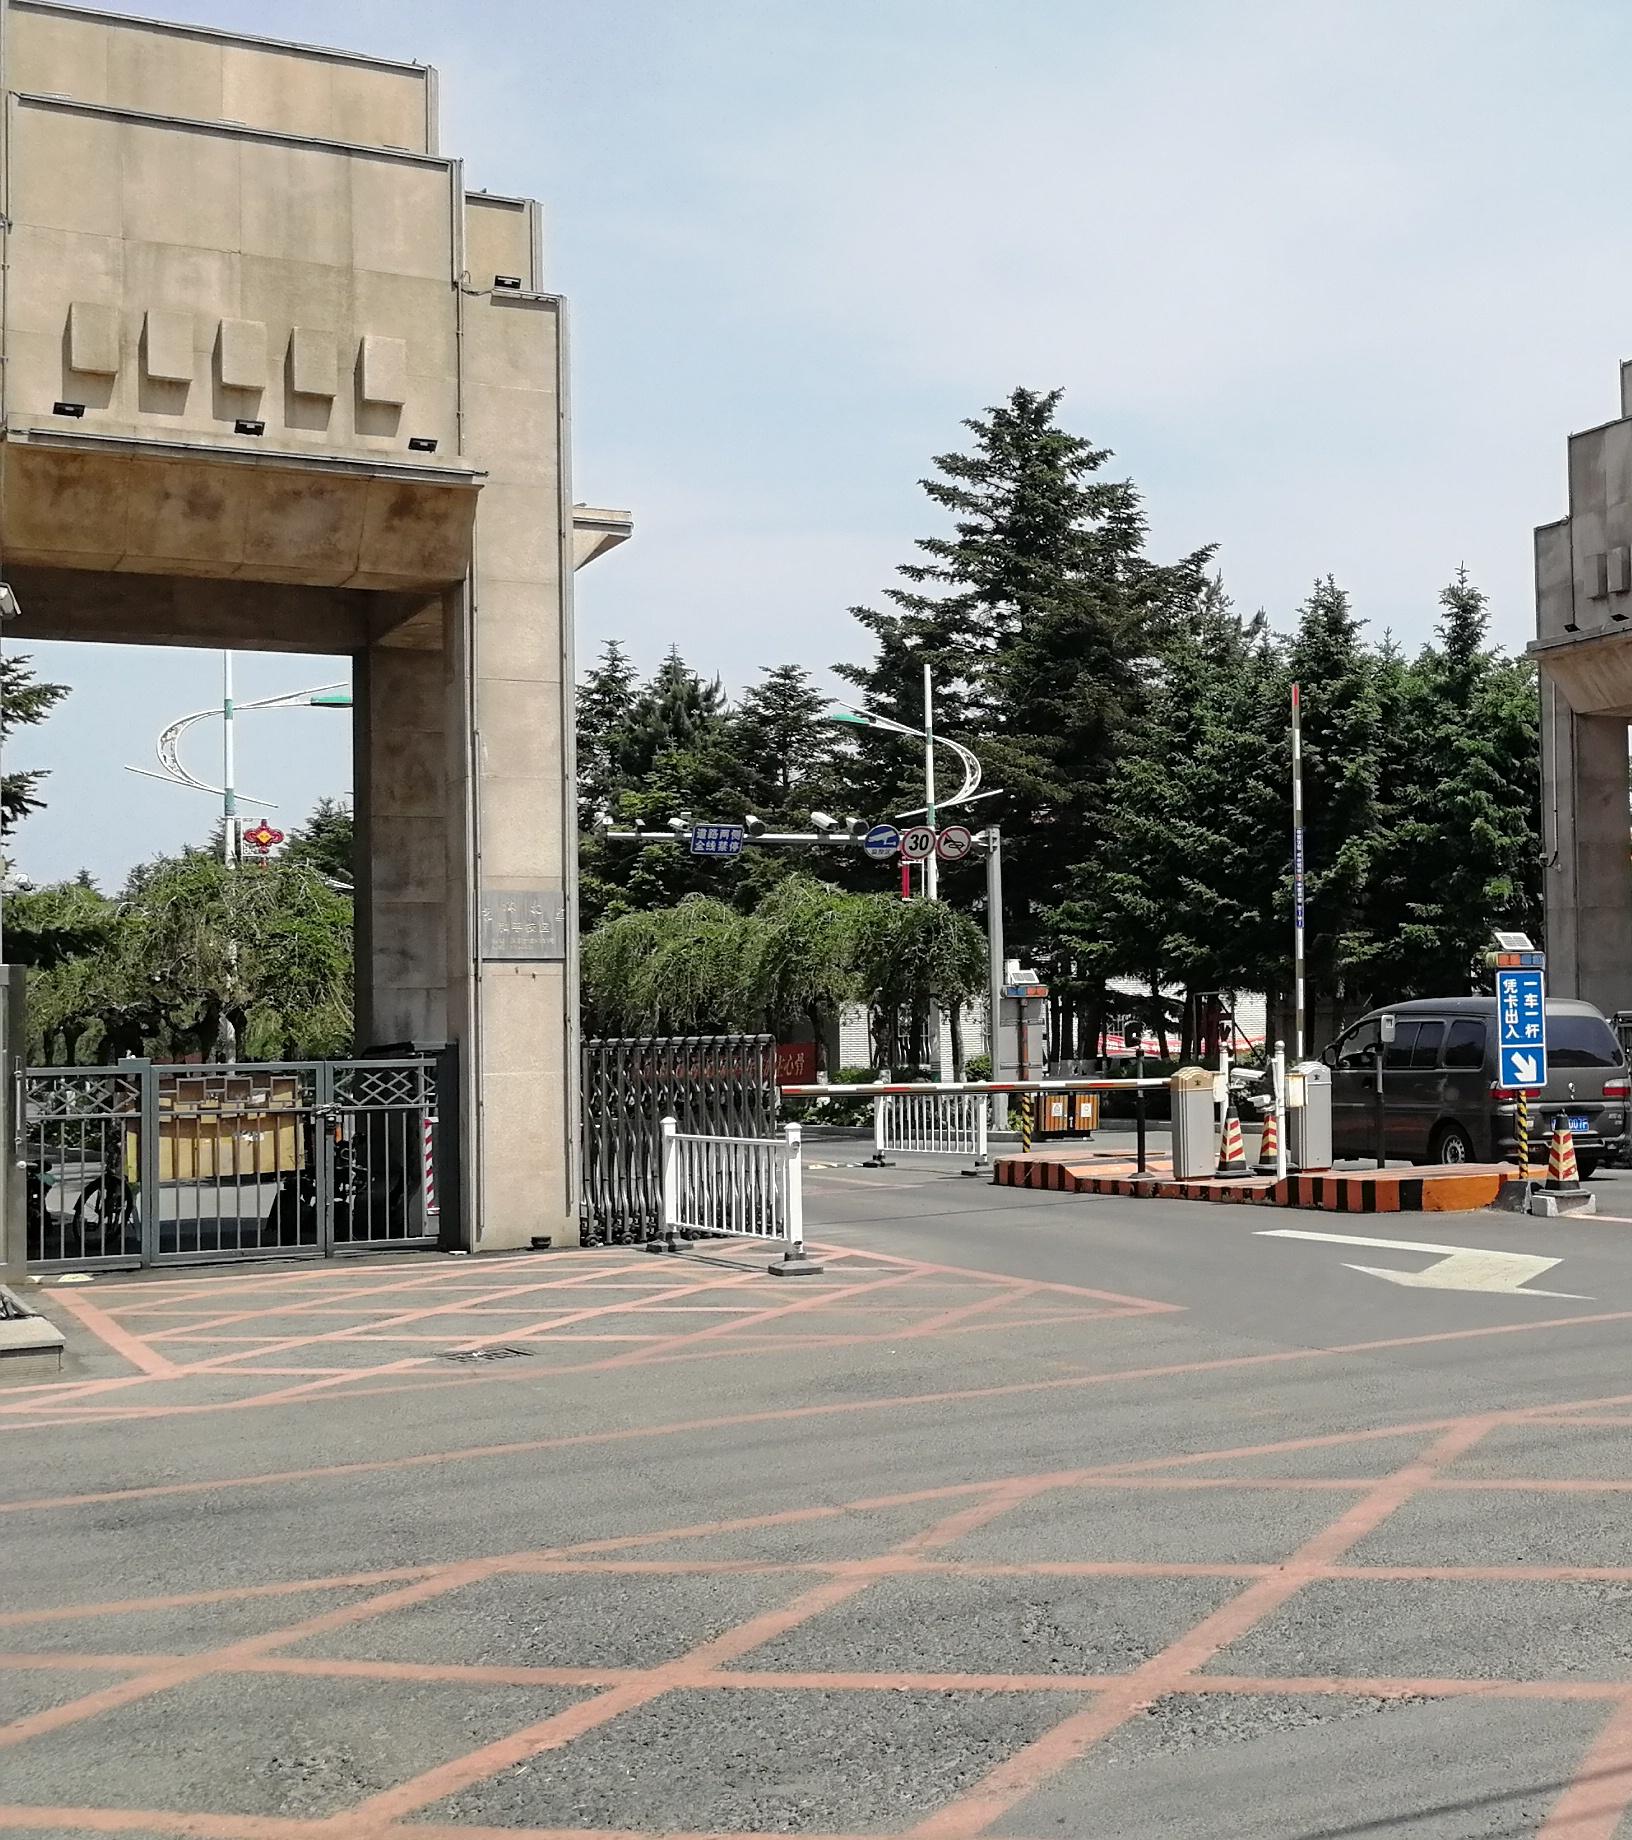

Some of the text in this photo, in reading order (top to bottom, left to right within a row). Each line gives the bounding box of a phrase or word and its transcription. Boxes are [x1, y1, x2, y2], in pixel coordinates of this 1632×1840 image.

[697, 828, 742, 840] 道路两侧
[909, 834, 929, 851] 30
[694, 840, 740, 852] 全线禁停
[1503, 979, 1520, 1039] 凭卡出入
[1524, 981, 1540, 1039] 一车一杆
